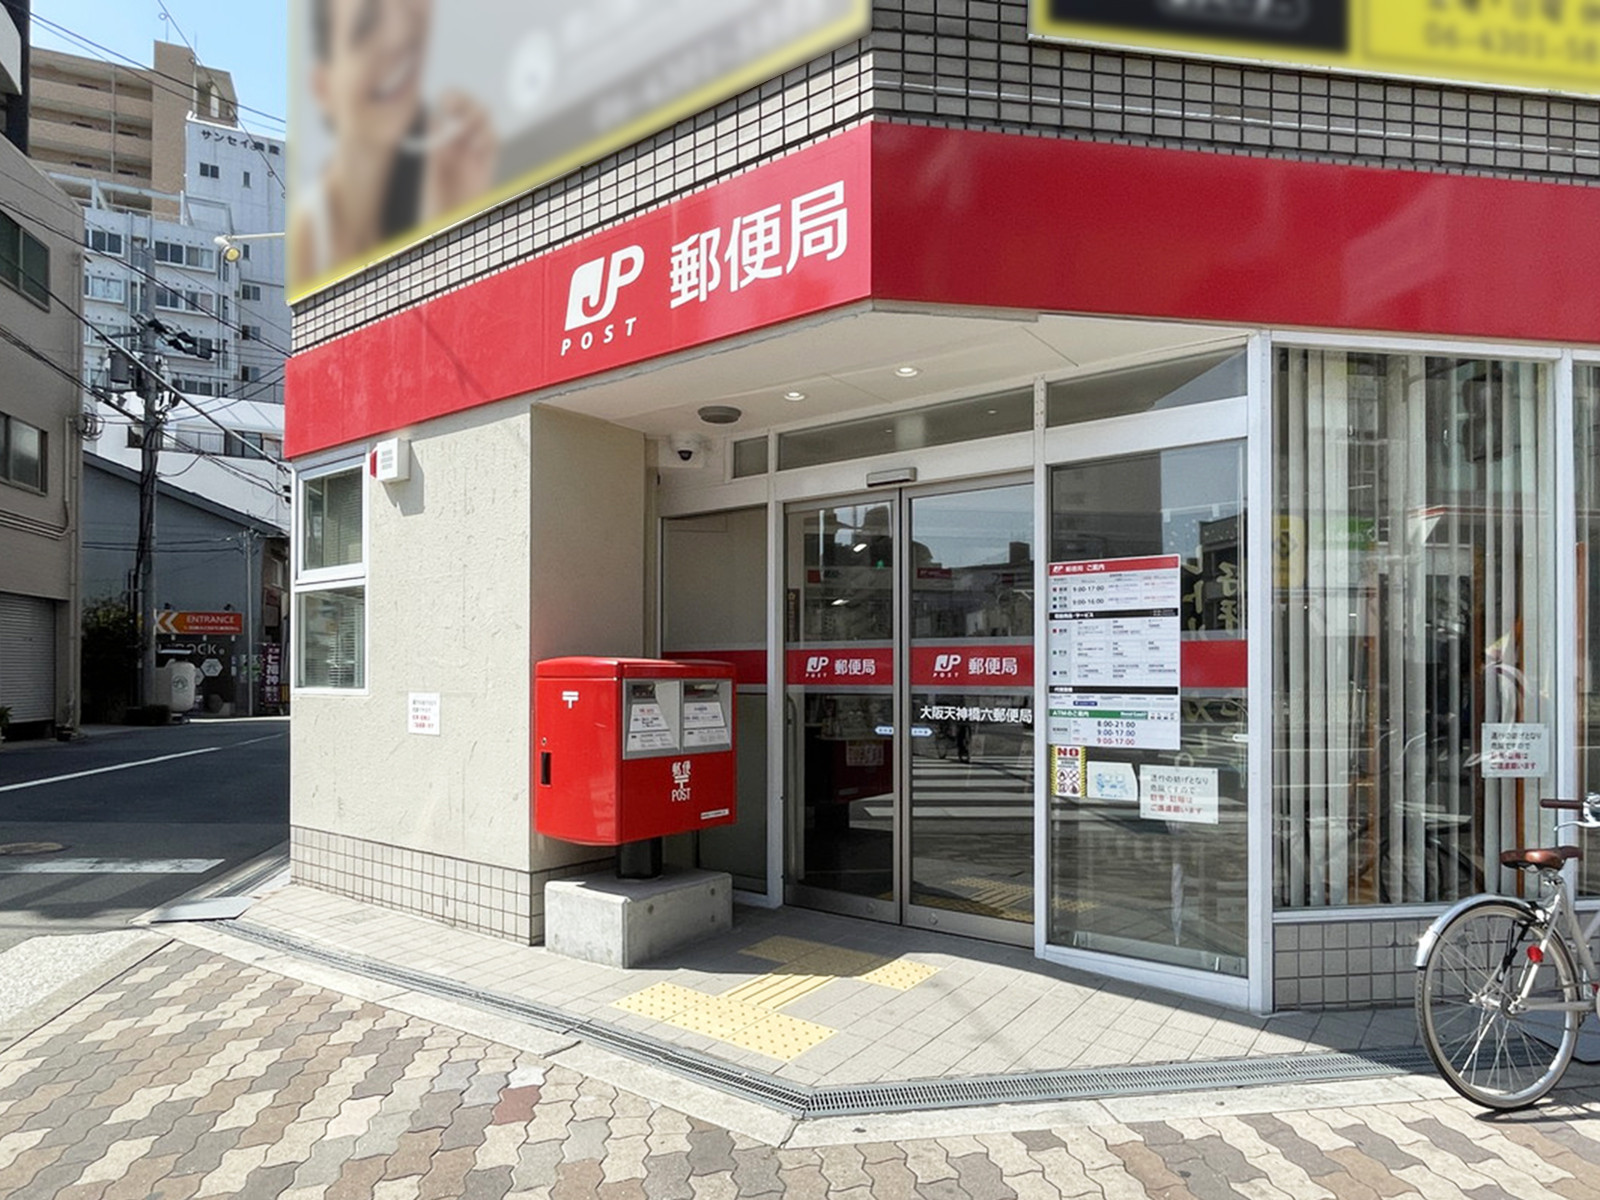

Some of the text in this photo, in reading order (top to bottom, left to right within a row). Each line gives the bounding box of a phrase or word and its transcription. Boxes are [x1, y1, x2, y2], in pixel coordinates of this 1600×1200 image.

[669, 180, 848, 309] 郵便局
[560, 317, 637, 355] POST
[186, 615, 235, 624] ENTRANCE
[834, 658, 876, 675] 郵便局
[968, 657, 1018, 675] 郵便局
[920, 705, 1033, 724] 大阪天神橋六郵便局
[1057, 747, 1079, 757] NO
[671, 788, 691, 802] POST
